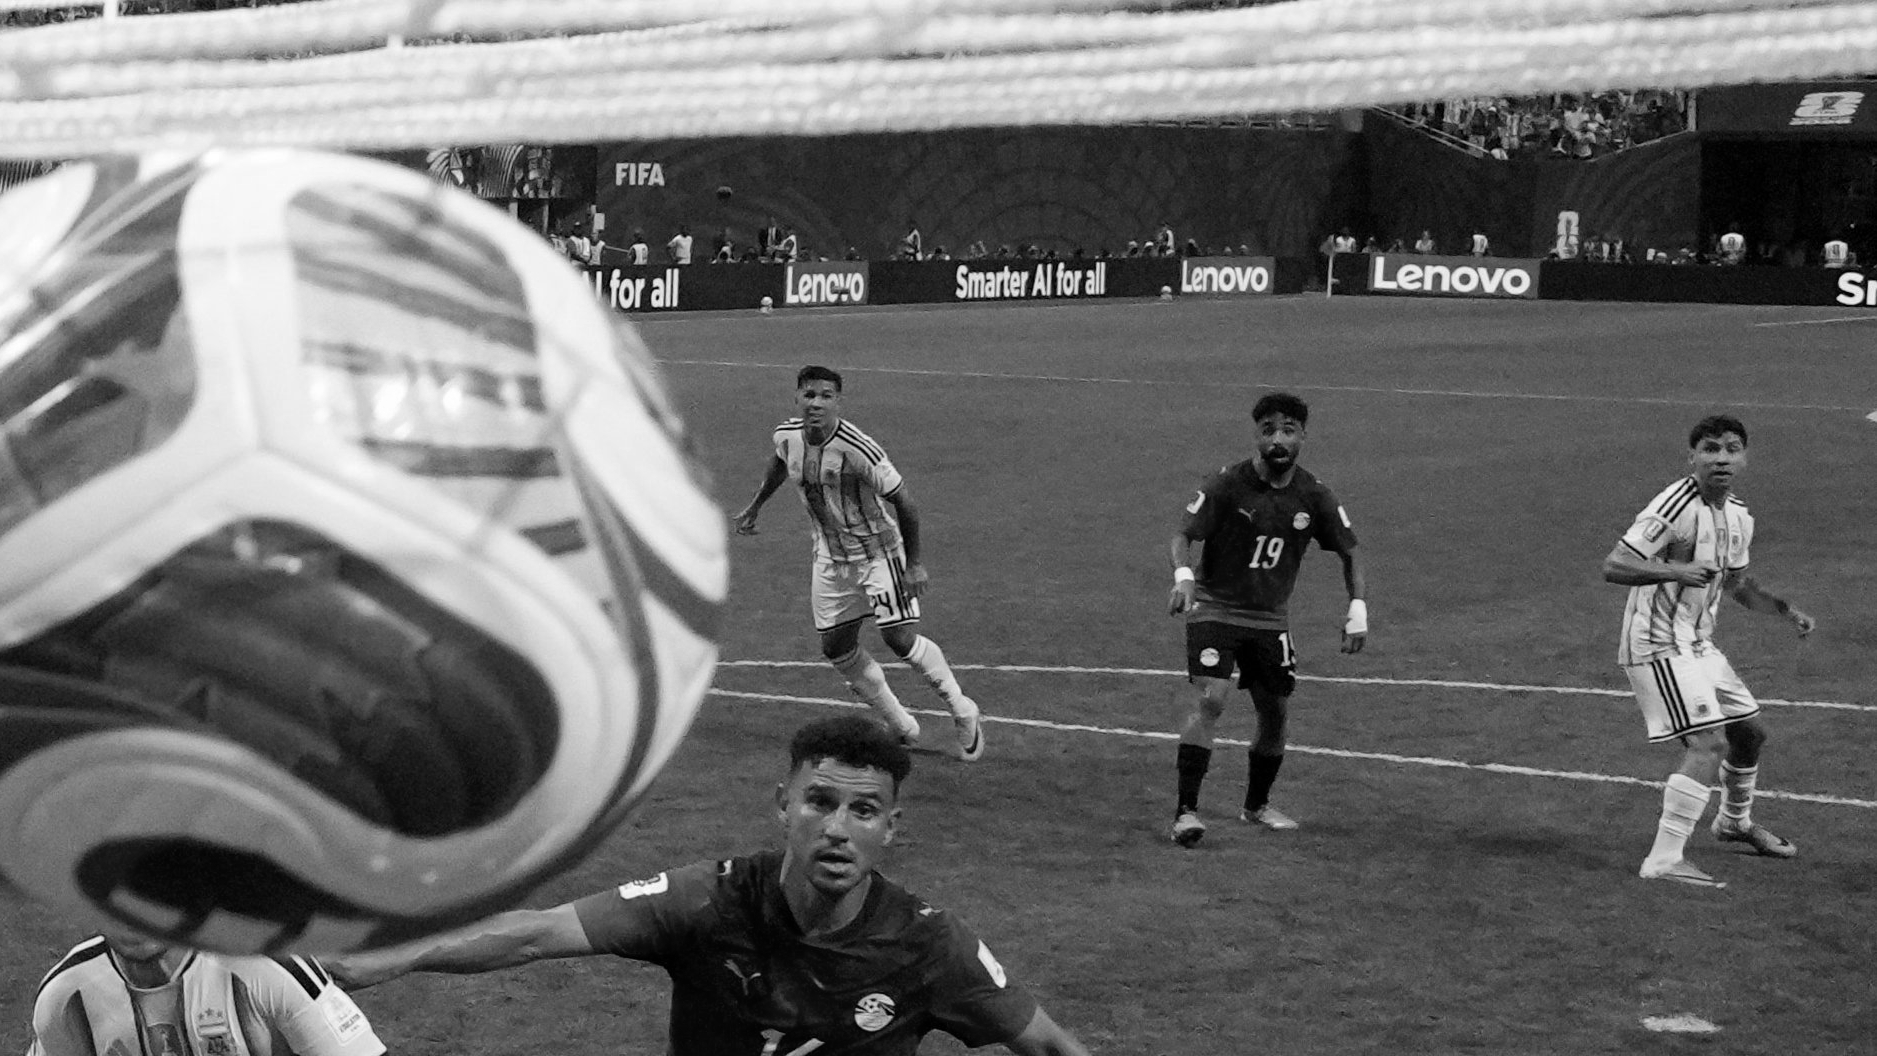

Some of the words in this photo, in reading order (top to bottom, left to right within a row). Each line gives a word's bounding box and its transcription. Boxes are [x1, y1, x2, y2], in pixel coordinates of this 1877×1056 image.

[615, 162, 665, 187] FIFA
[610, 268, 646, 309] for
[651, 268, 679, 308] all
[786, 265, 865, 305] Lenovo
[955, 264, 1029, 300] Smarter
[1031, 263, 1053, 297] AI
[1055, 262, 1083, 297] for
[1085, 261, 1106, 296] all
[1181, 260, 1269, 293] Lenovo
[1373, 256, 1531, 295] Lenovo
[1248, 535, 1285, 569] 19
[1278, 632, 1297, 668] 1
